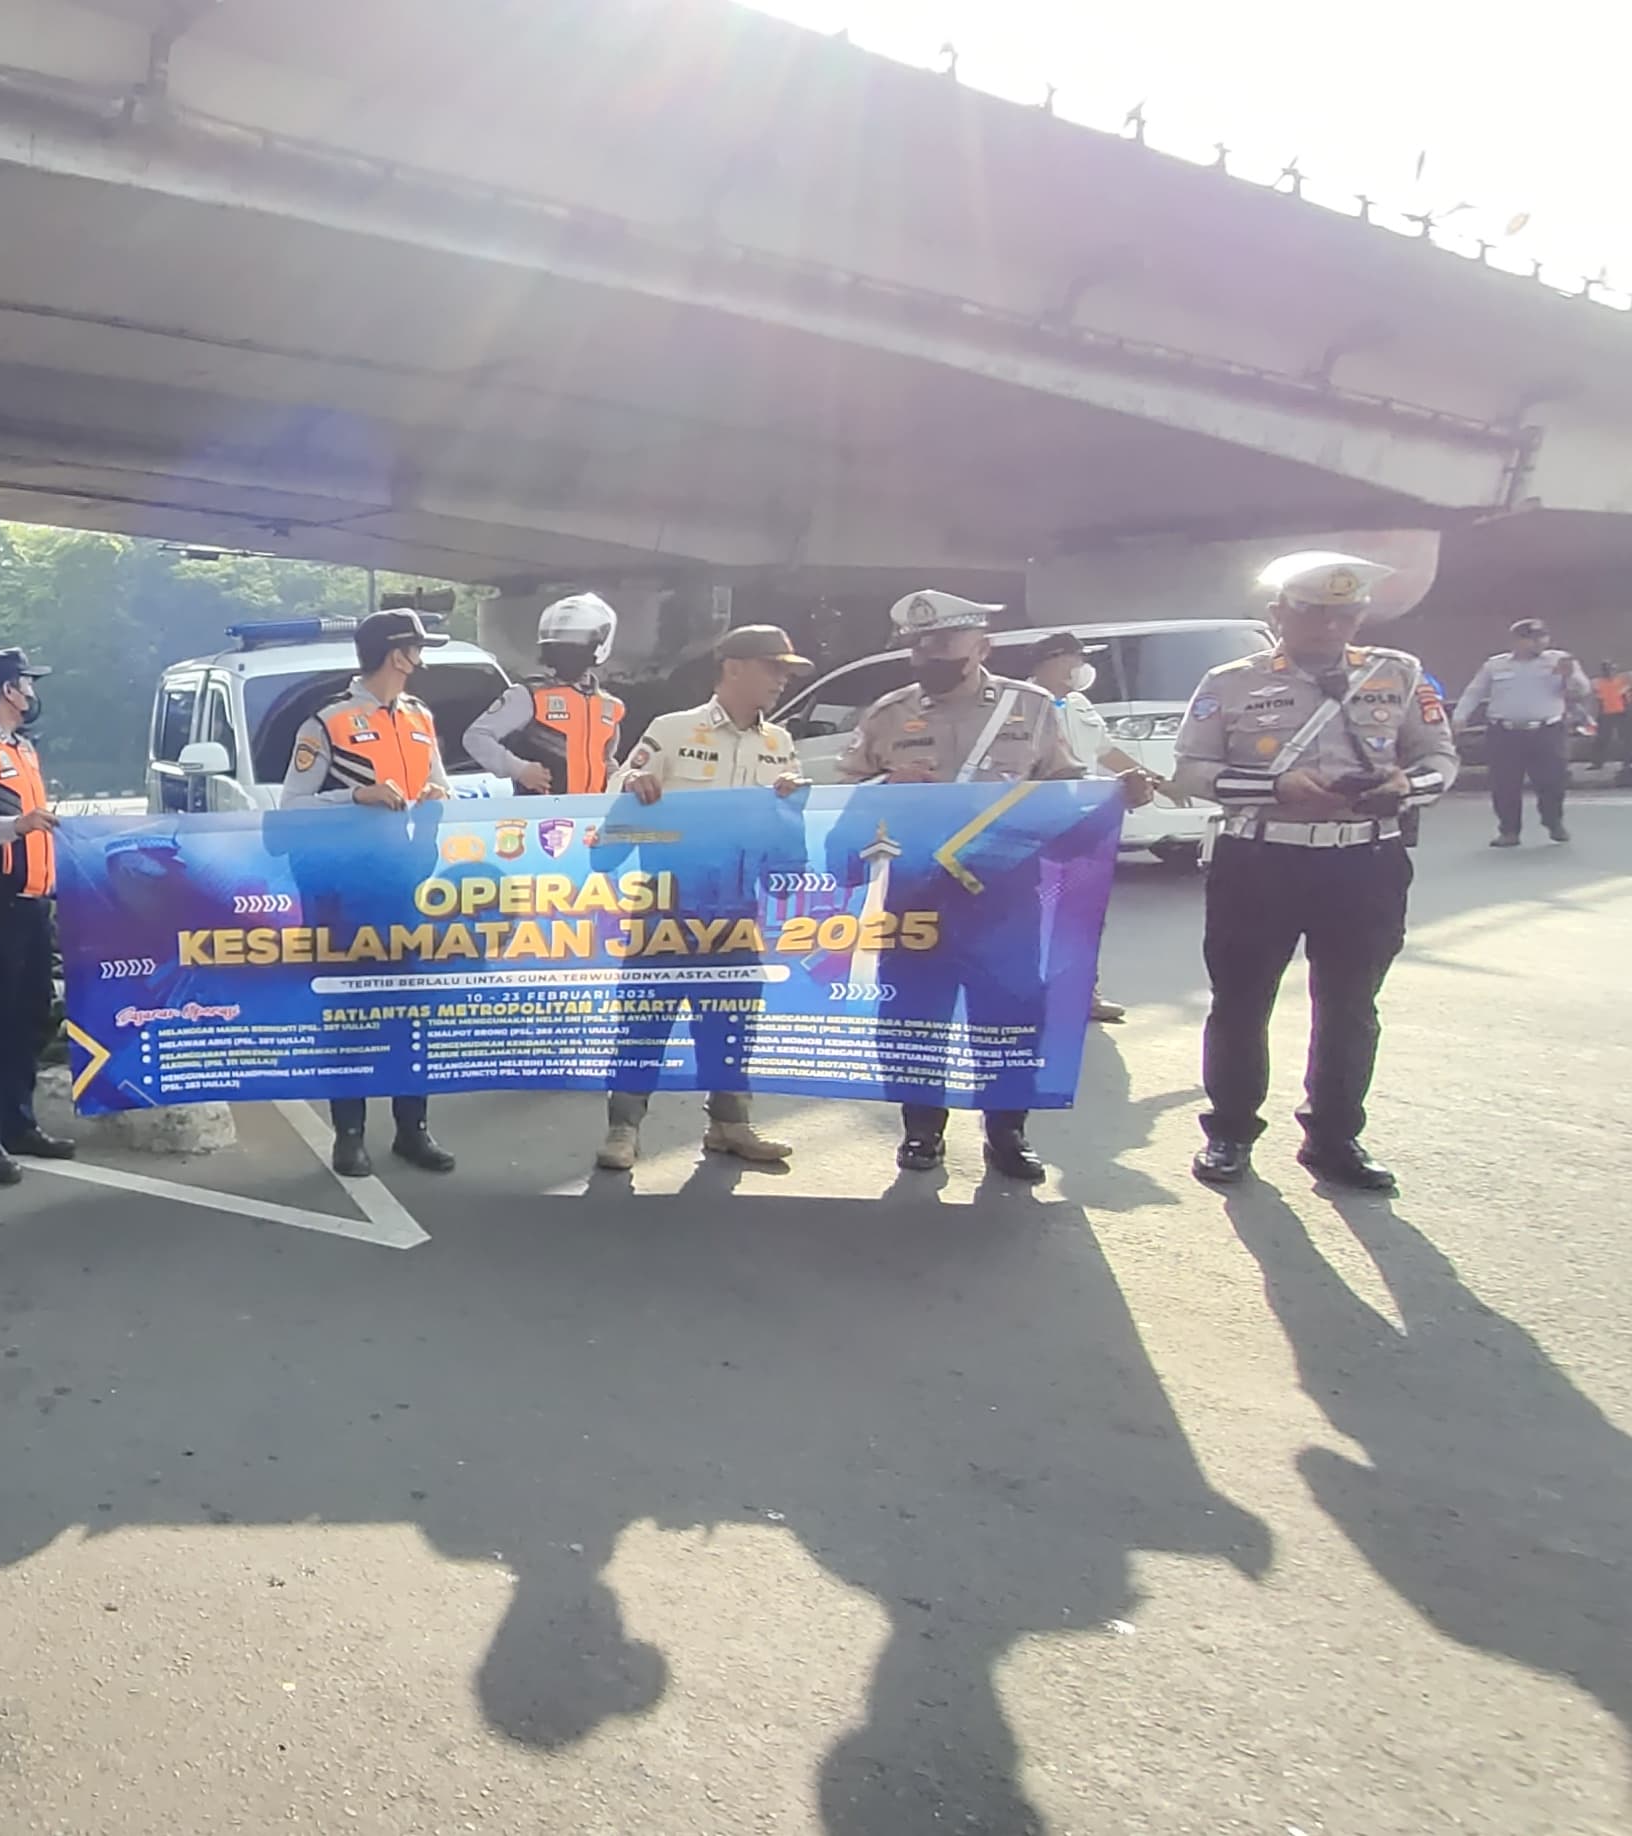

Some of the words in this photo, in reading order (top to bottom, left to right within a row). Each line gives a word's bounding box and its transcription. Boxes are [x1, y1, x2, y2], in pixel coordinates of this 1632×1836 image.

[1245, 698, 1295, 711] ANTON
[1352, 694, 1402, 705] POLRI
[678, 748, 718, 761] KARIM
[414, 871, 674, 917] OPERASI
[178, 919, 594, 966] KESELAMATAN
[605, 918, 766, 957] JAYA
[776, 911, 940, 952] 2025
[399, 977, 460, 987] BERLALU
[465, 975, 512, 985] LINTAS
[518, 973, 557, 983] GUNA
[562, 971, 669, 982] TERWUJUDNYA
[675, 970, 712, 980] ASTA
[466, 993, 483, 1003] 10
[501, 992, 520, 1002] 23
[527, 990, 610, 1001] FEBRUARI
[618, 989, 656, 999] 2025
[322, 1005, 431, 1022] SATLANTAS
[437, 1000, 592, 1017] METROPOLITAN
[598, 998, 692, 1014] JAKARTA
[699, 1000, 766, 1012] TIMUR
